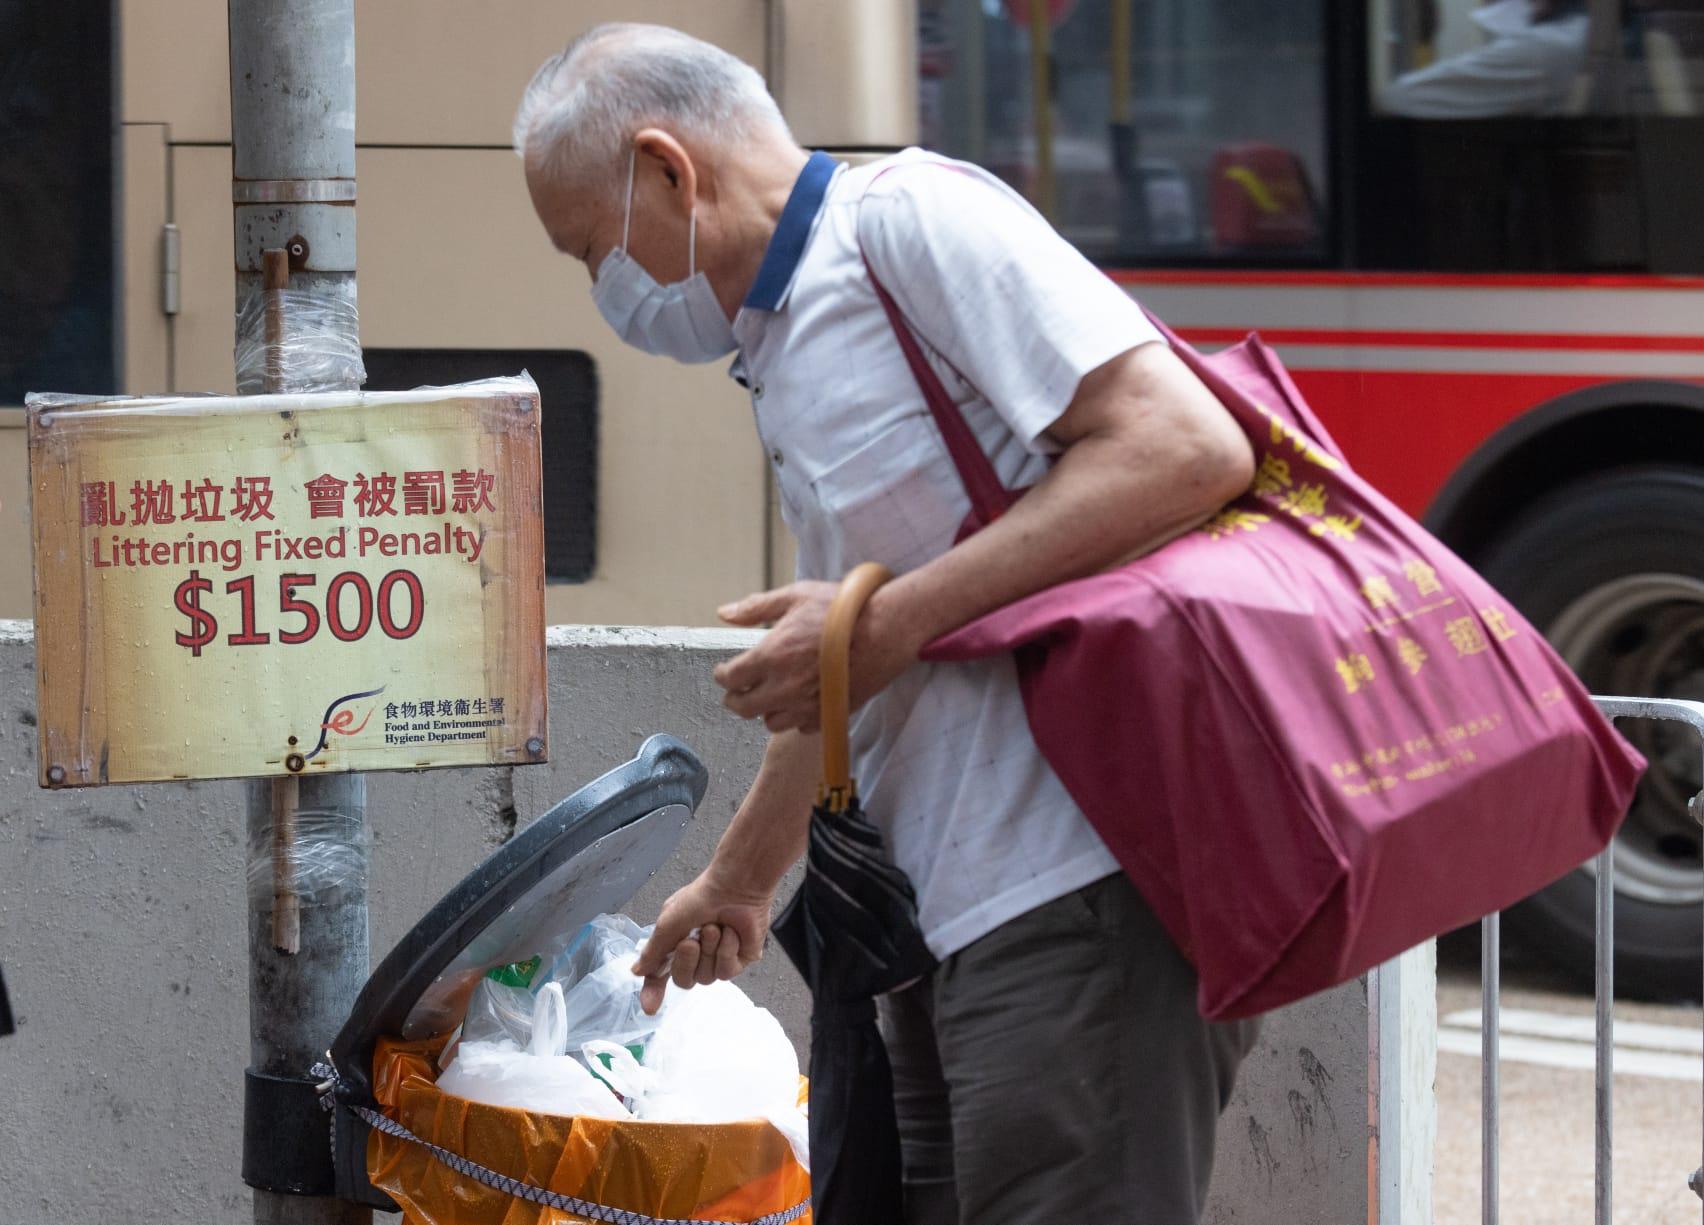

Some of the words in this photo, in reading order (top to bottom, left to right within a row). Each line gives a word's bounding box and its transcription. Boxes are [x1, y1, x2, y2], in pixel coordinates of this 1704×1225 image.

[80, 476, 276, 528] 亂拋垃圾
[303, 468, 496, 520] 會被罰款
[93, 532, 242, 572] Littering
[255, 526, 347, 561] Fixed
[358, 522, 483, 563] Penalty
[174, 570, 425, 657] $1500
[385, 722, 409, 732] Food
[412, 721, 430, 731] and
[433, 718, 505, 730] Environmental
[385, 733, 425, 745] Hygiene
[428, 730, 486, 742] Department
